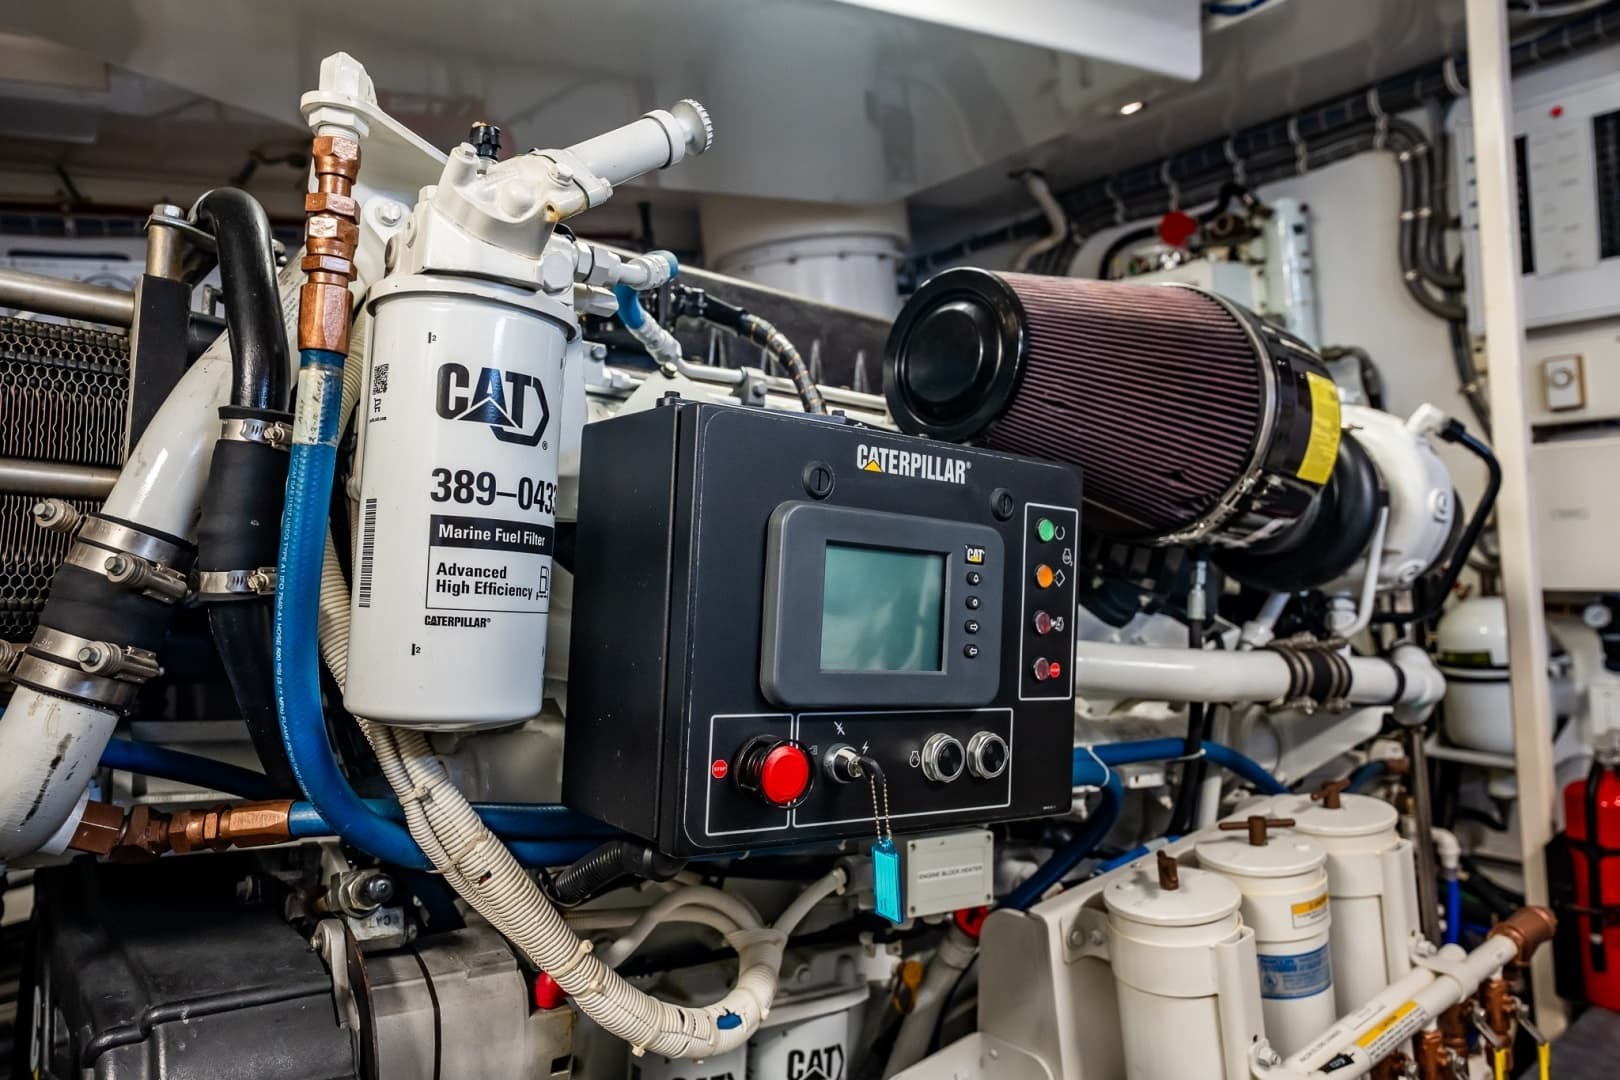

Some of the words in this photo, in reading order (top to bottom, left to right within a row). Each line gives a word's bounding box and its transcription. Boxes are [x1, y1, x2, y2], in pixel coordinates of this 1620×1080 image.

[435, 362, 537, 432] CAT
[438, 523, 492, 542] Marine
[495, 527, 521, 544] Fuel
[523, 530, 546, 548] Filter
[436, 561, 508, 580] Advanced
[436, 579, 470, 597] High
[474, 580, 533, 601] Efficiency
